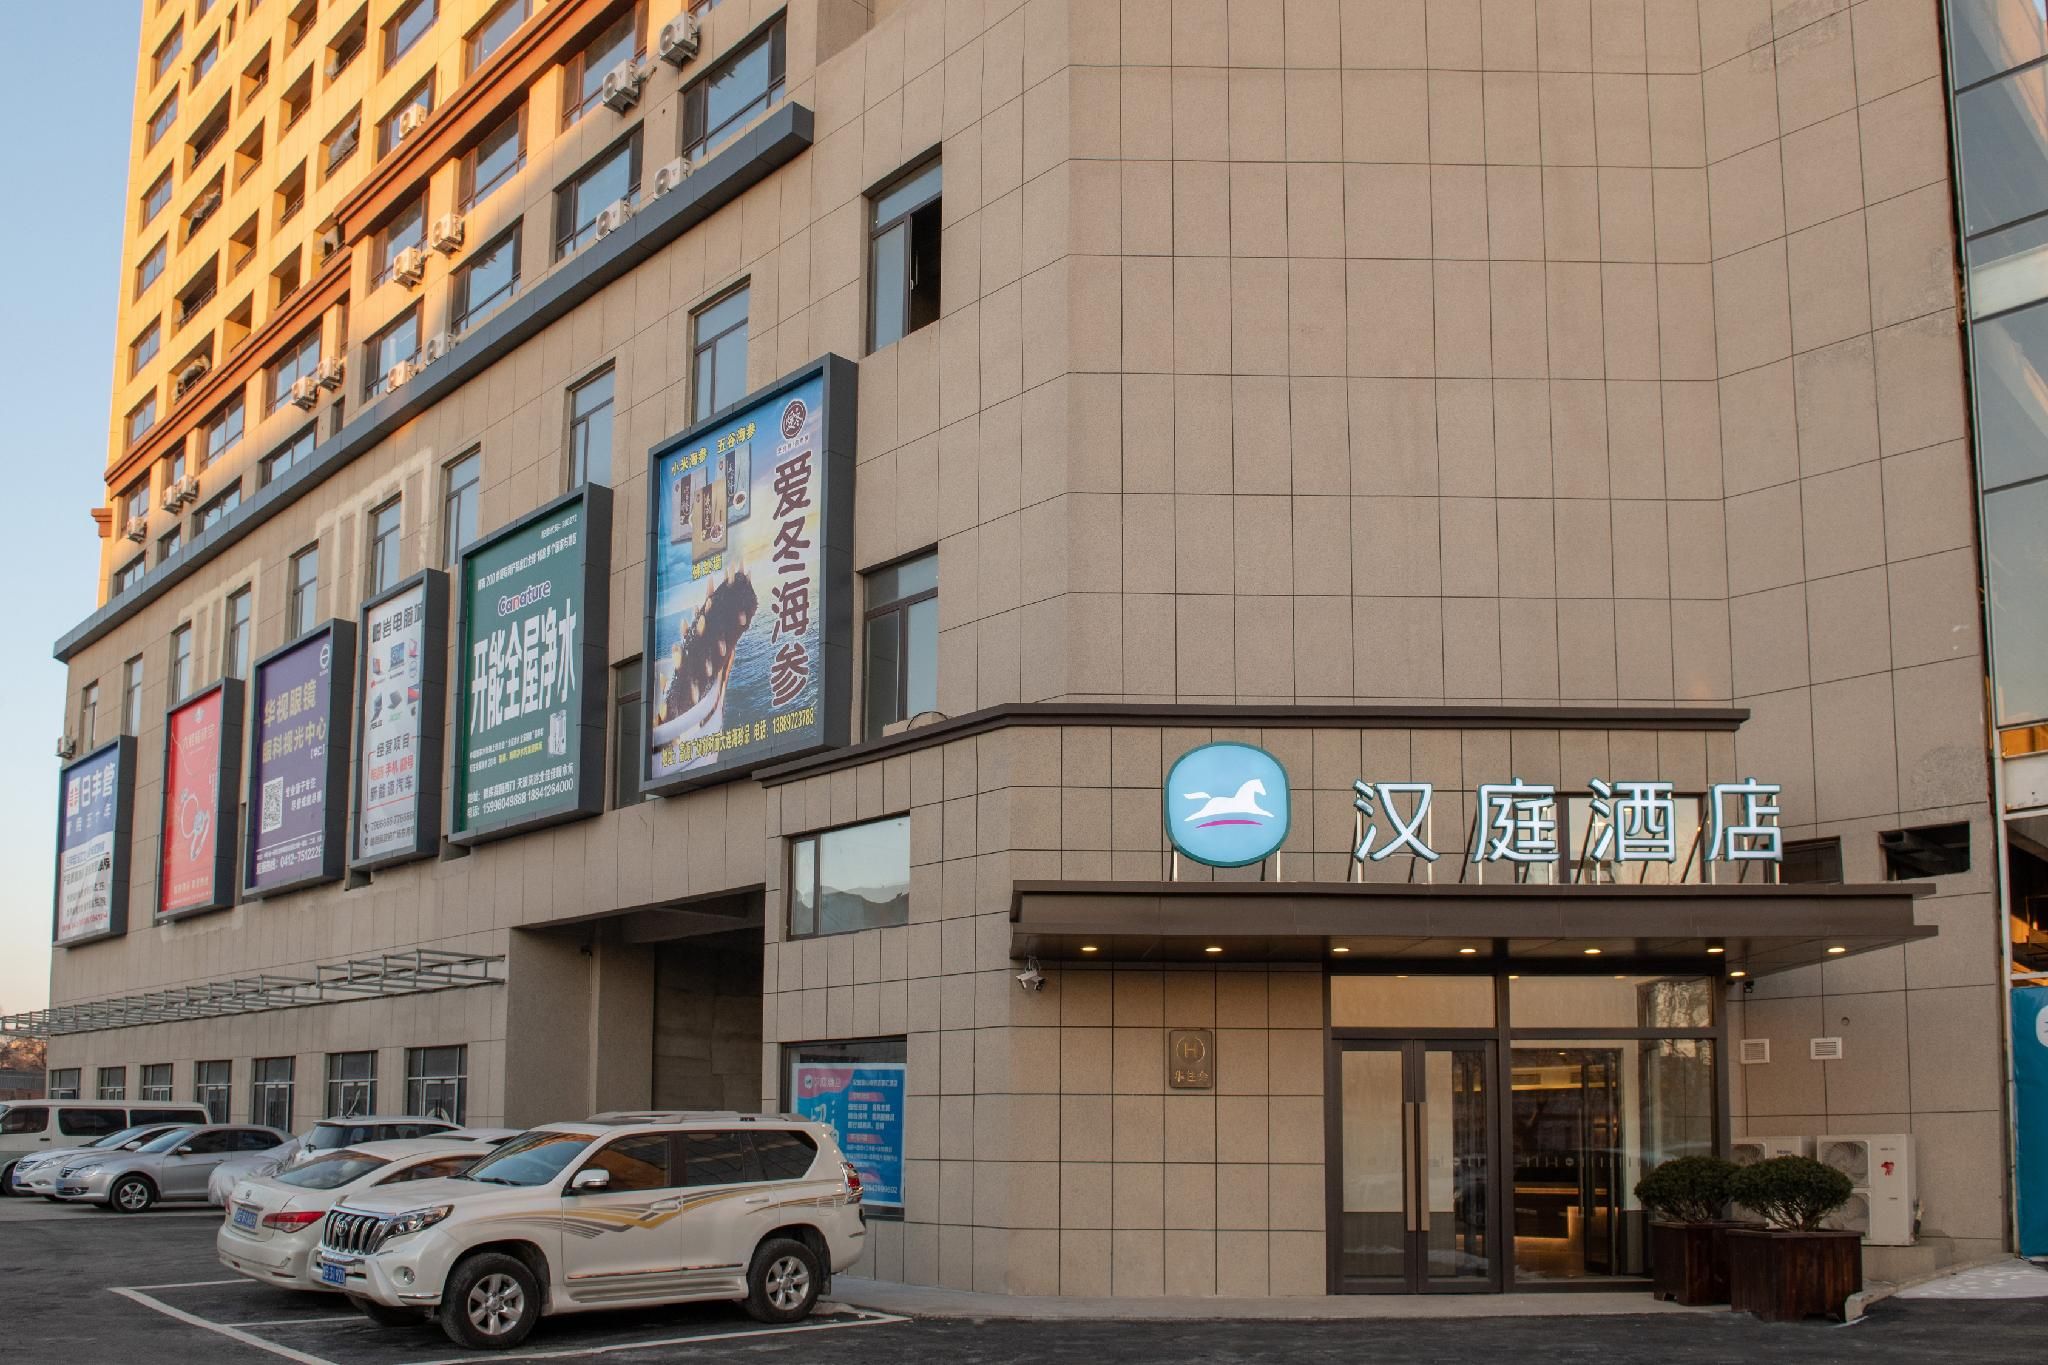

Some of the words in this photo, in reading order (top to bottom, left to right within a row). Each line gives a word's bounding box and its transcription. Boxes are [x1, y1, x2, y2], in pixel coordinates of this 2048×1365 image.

[717, 422, 757, 453] 五谷海参
[497, 580, 551, 616] Canature
[771, 450, 813, 708] 爱冬海参
[470, 598, 577, 736] 开能全屋净水
[263, 678, 317, 728] 华视眼镜
[262, 716, 327, 764] 眼科视光中心
[376, 732, 410, 758] 经营项目
[370, 774, 413, 802] 新能源汽车
[1353, 776, 1784, 864] 汉庭酒店
